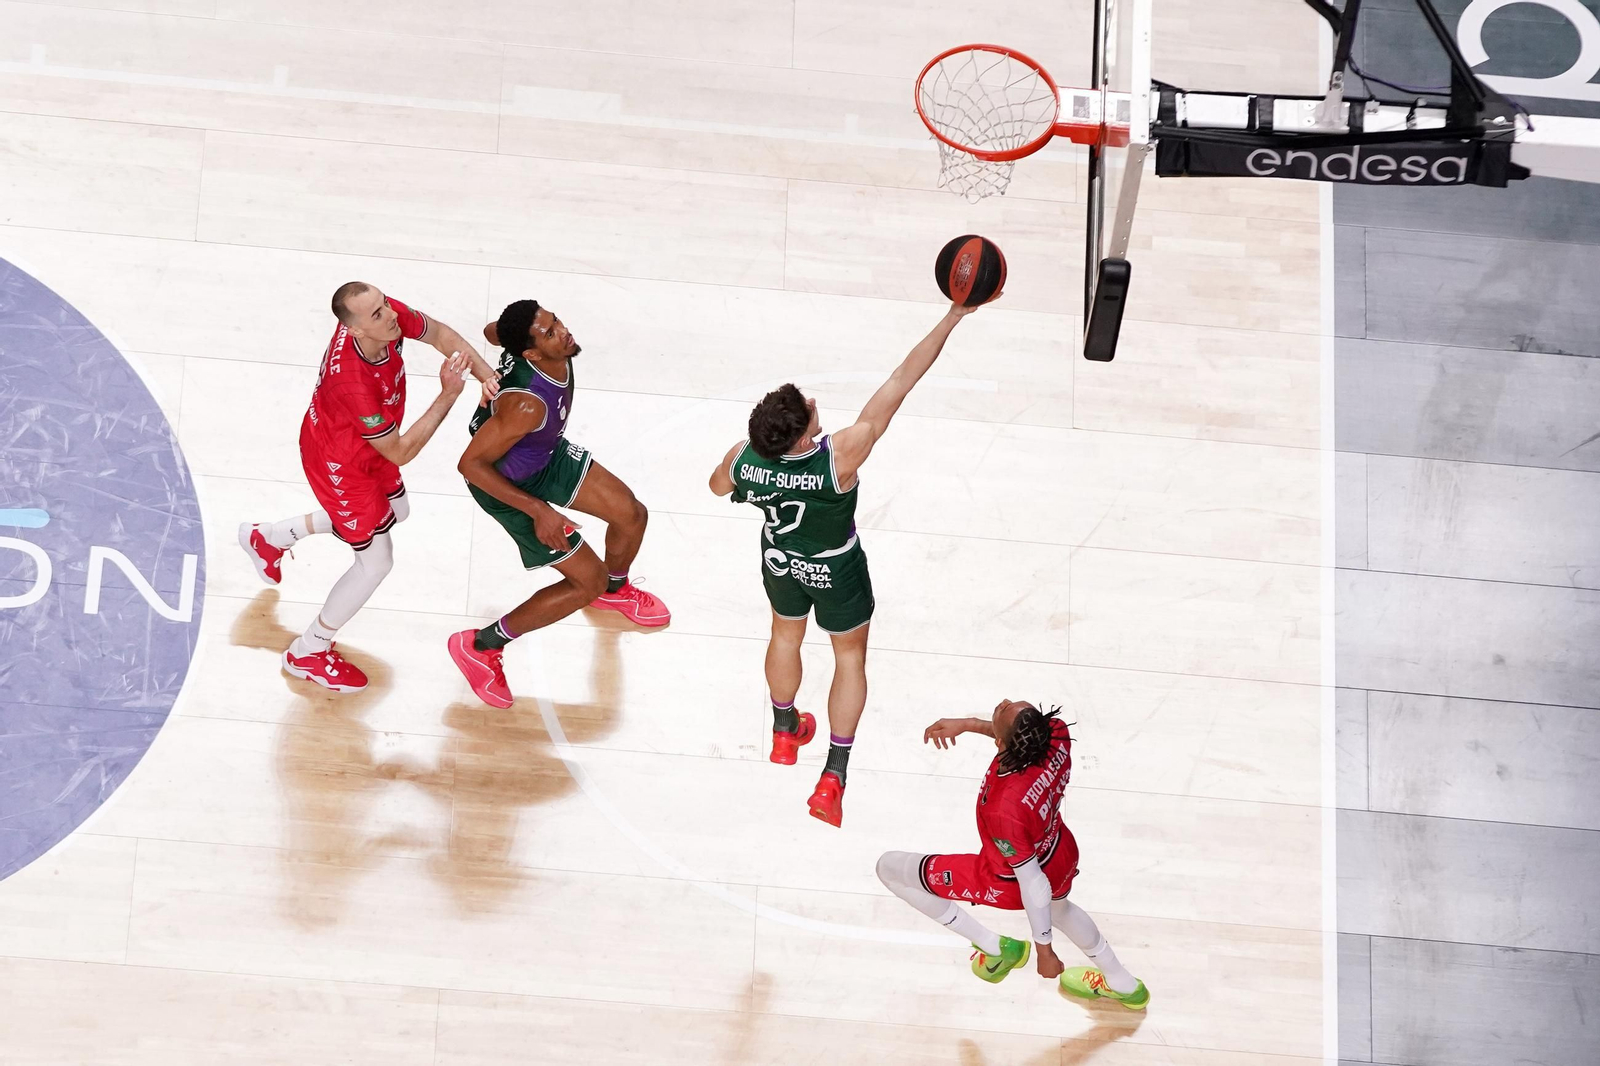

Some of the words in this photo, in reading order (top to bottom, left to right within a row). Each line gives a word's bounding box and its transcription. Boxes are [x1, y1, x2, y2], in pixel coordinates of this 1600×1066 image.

[1245, 145, 1469, 184] endesa
[741, 464, 824, 490] SAINT-SUPÉRY
[766, 500, 807, 535] 17
[791, 559, 831, 574] COSTA
[810, 572, 832, 583] SOL
[1020, 742, 1069, 811] THOMASSON
